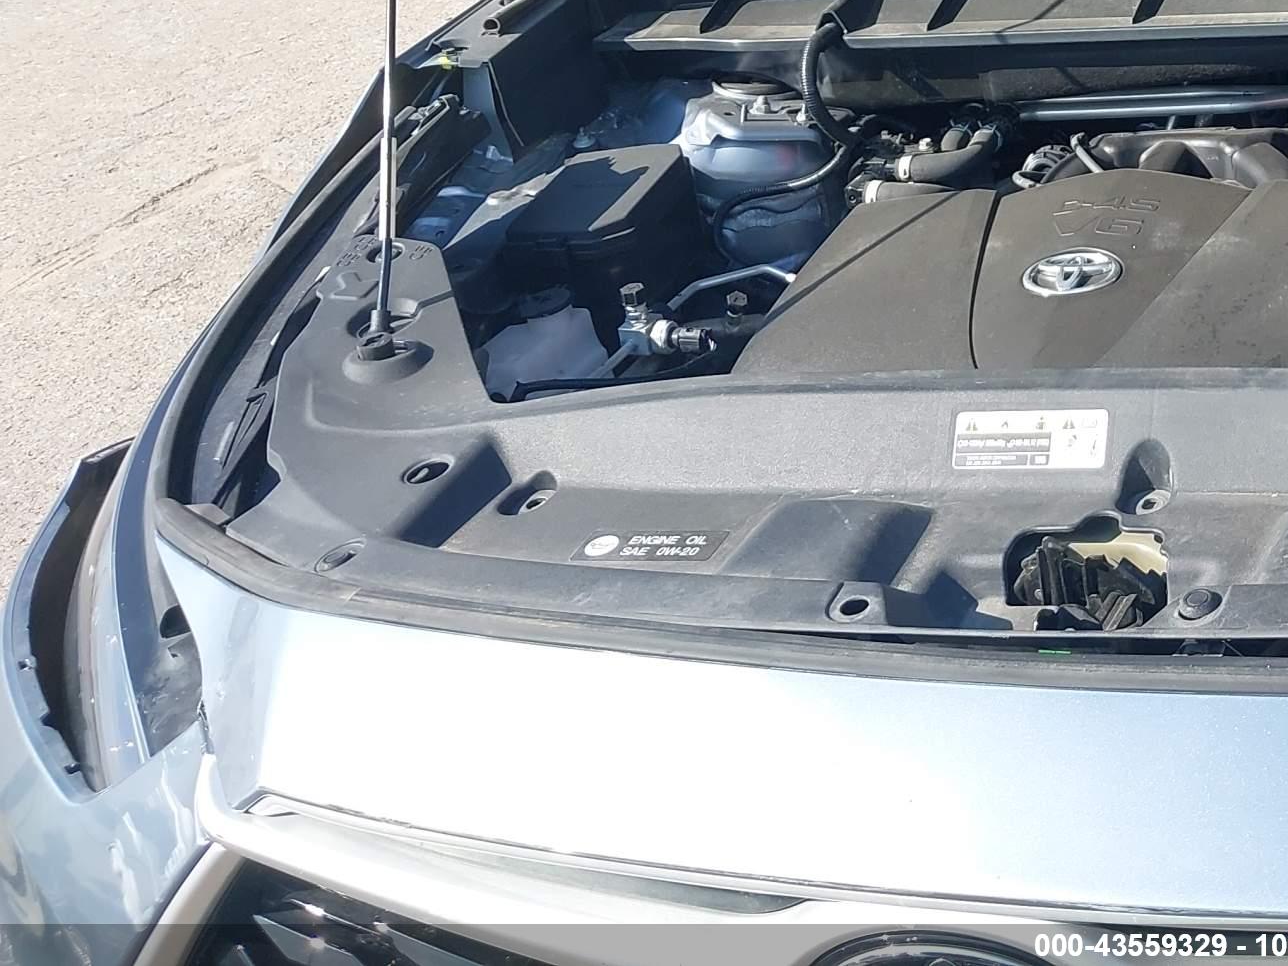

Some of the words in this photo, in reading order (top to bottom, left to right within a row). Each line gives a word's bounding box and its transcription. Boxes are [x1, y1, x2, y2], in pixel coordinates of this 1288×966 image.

[628, 535, 681, 545] ENGINE
[685, 535, 707, 545] OIL
[619, 546, 650, 556] SAE
[656, 546, 700, 556] 0W-20
